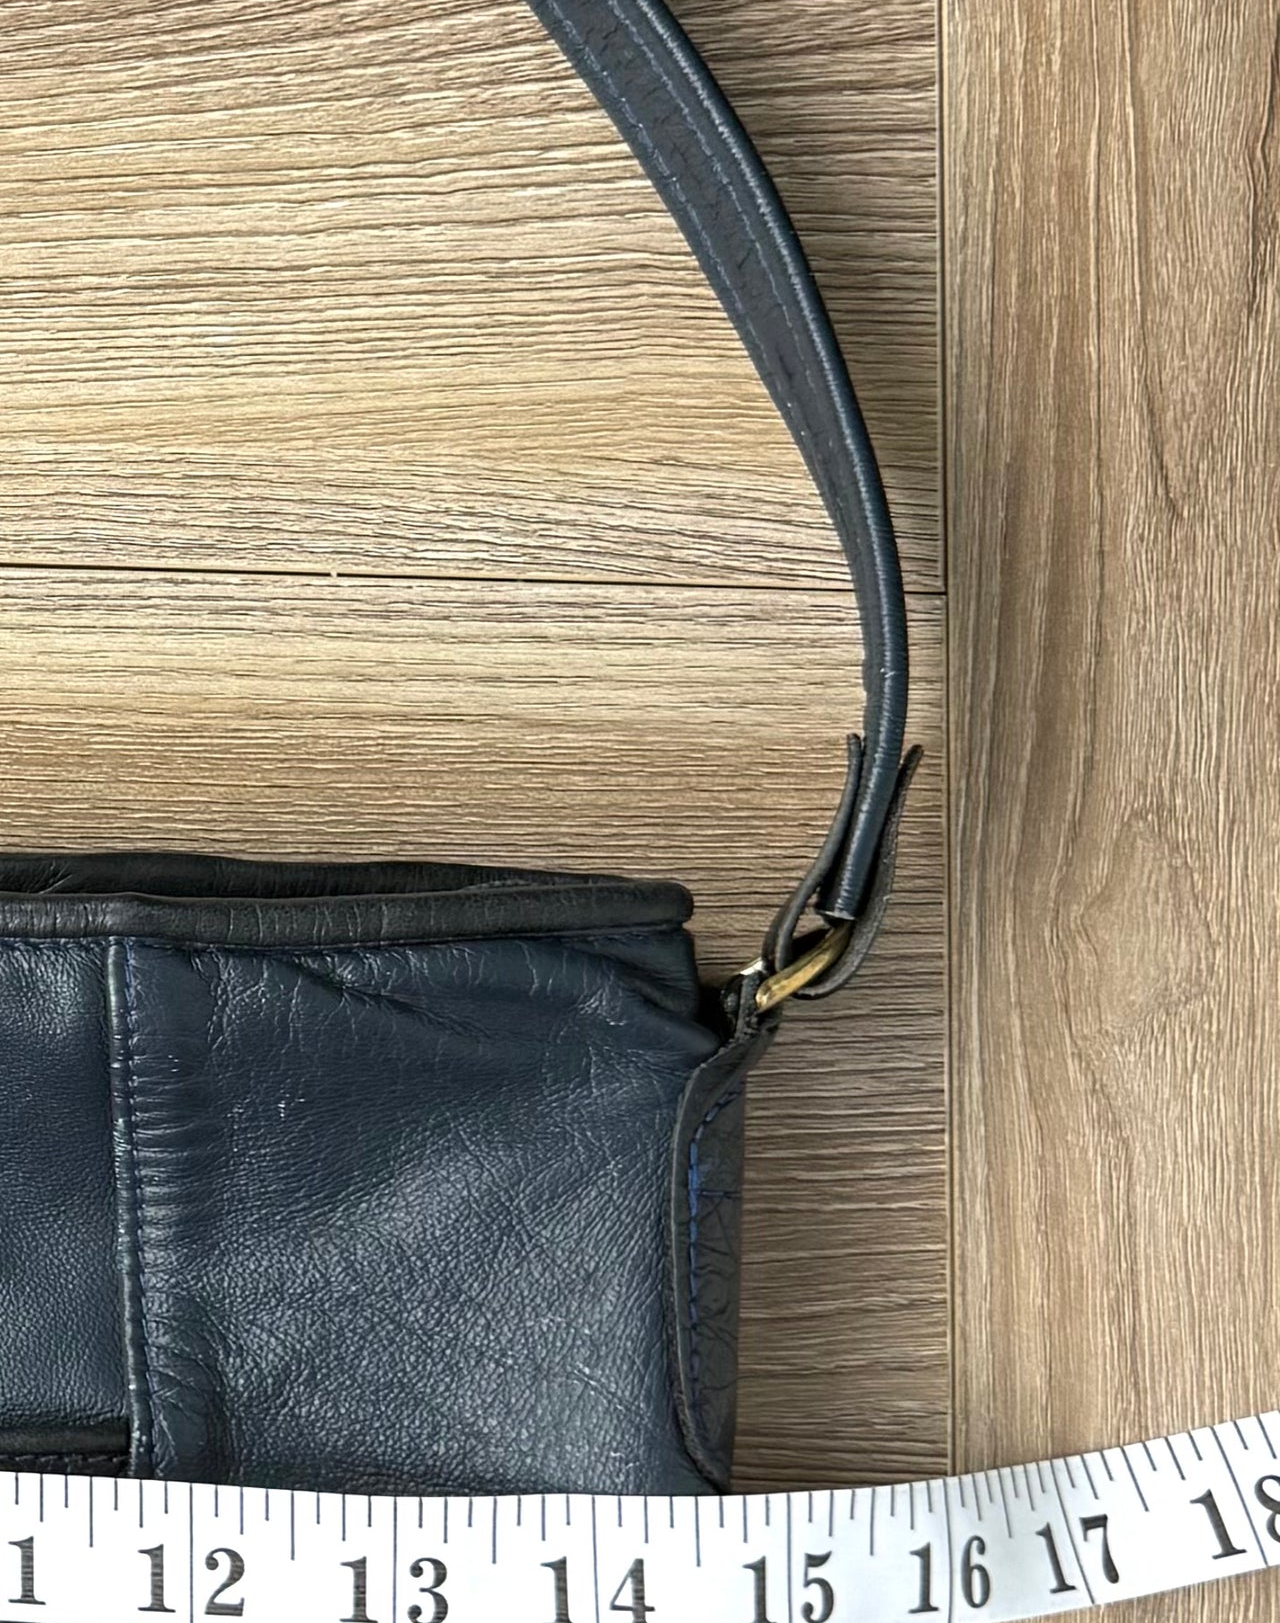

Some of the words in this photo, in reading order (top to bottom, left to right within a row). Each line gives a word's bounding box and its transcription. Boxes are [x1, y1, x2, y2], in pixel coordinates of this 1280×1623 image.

[137, 1544, 246, 1617] 12
[908, 1535, 991, 1614] 16
[1036, 1513, 1120, 1594] 17
